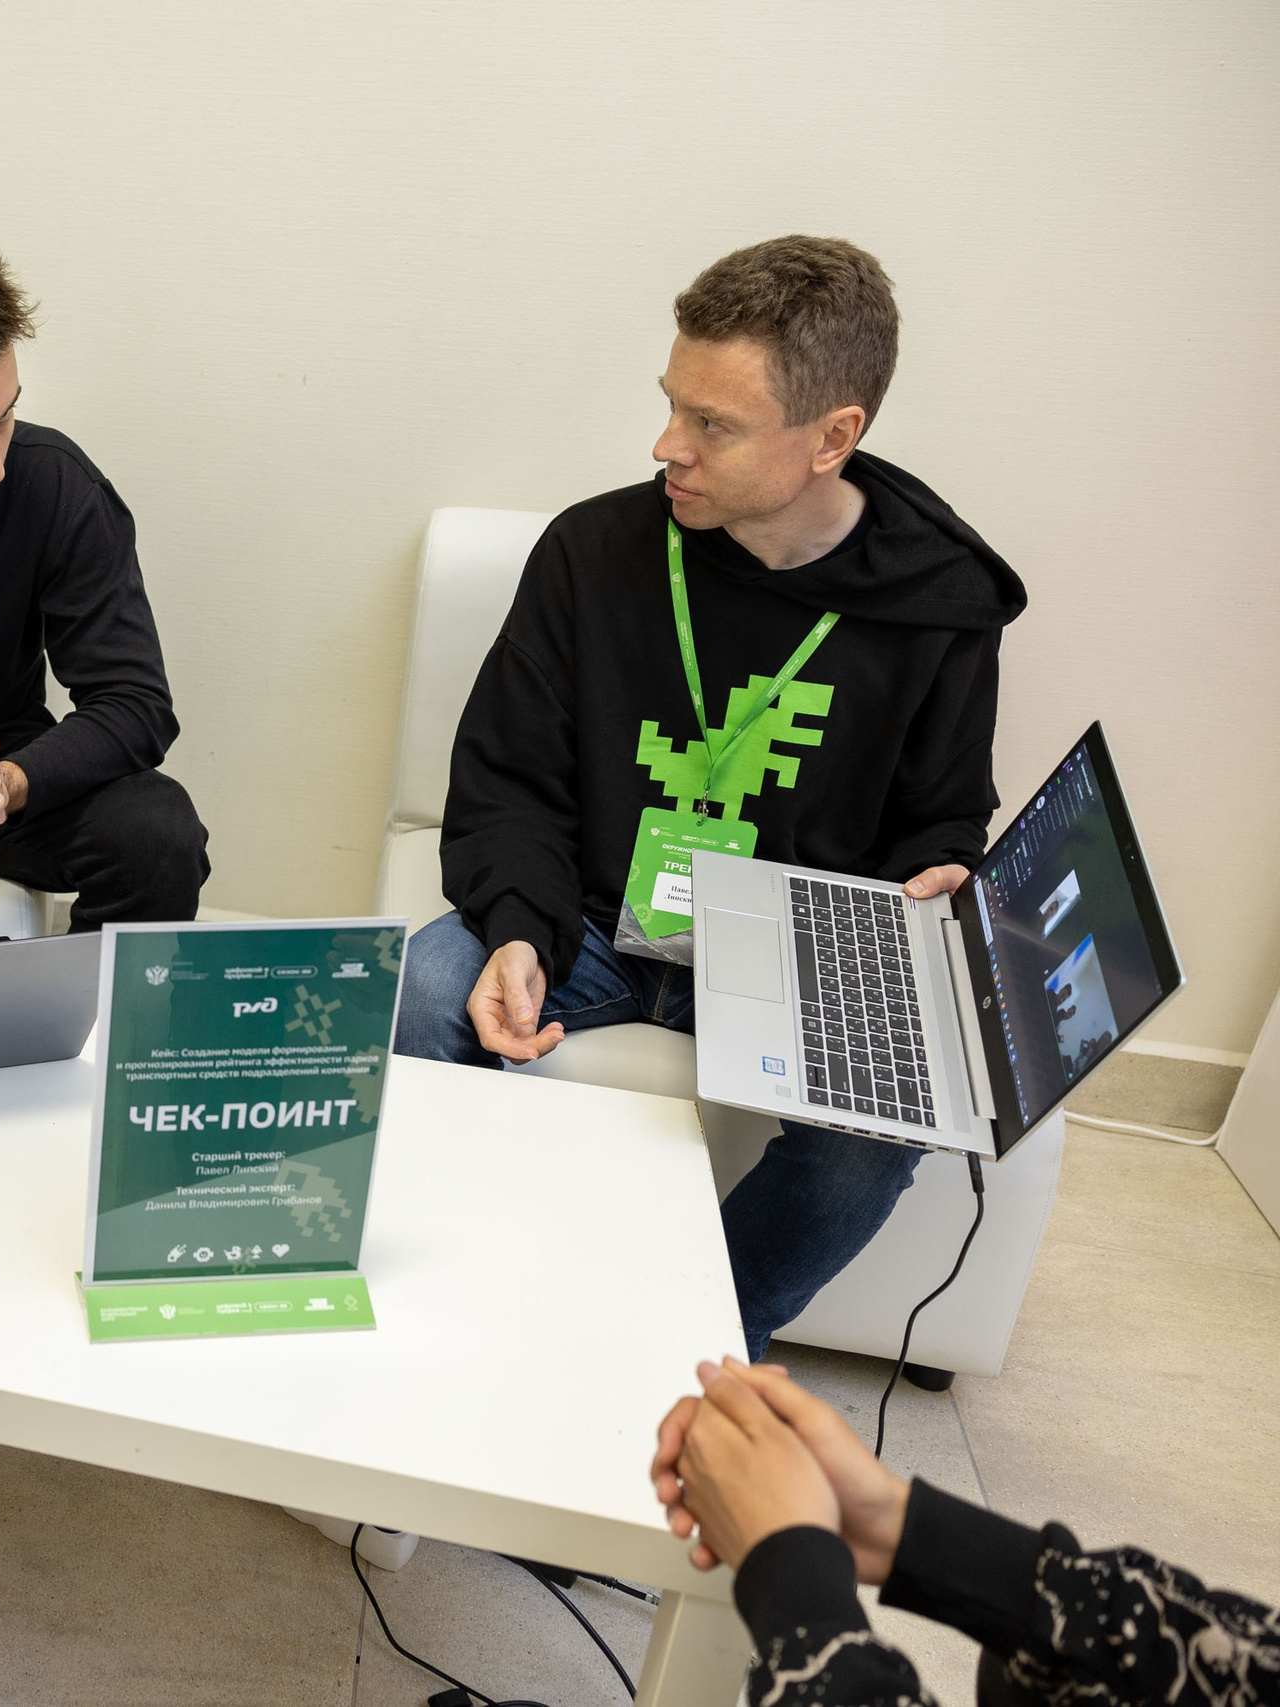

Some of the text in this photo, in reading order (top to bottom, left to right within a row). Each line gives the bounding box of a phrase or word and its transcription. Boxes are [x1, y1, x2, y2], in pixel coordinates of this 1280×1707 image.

[662, 843, 694, 853] ОКРУЖНО
[151, 1045, 348, 1058] Кейс: Создание модели формирования
[116, 1055, 379, 1070] и прогнозирования рейтинга эффективности парков
[126, 1066, 370, 1082] транспортных средств подразделений компании
[129, 1099, 357, 1132] ЧЕК-ПОИНТ
[192, 1151, 286, 1162] Старший трекер:
[196, 1164, 279, 1176] Павел Липский
[176, 1183, 296, 1196] Технический эксперт:
[145, 1196, 322, 1212] Данила Владимирович Грибанов
